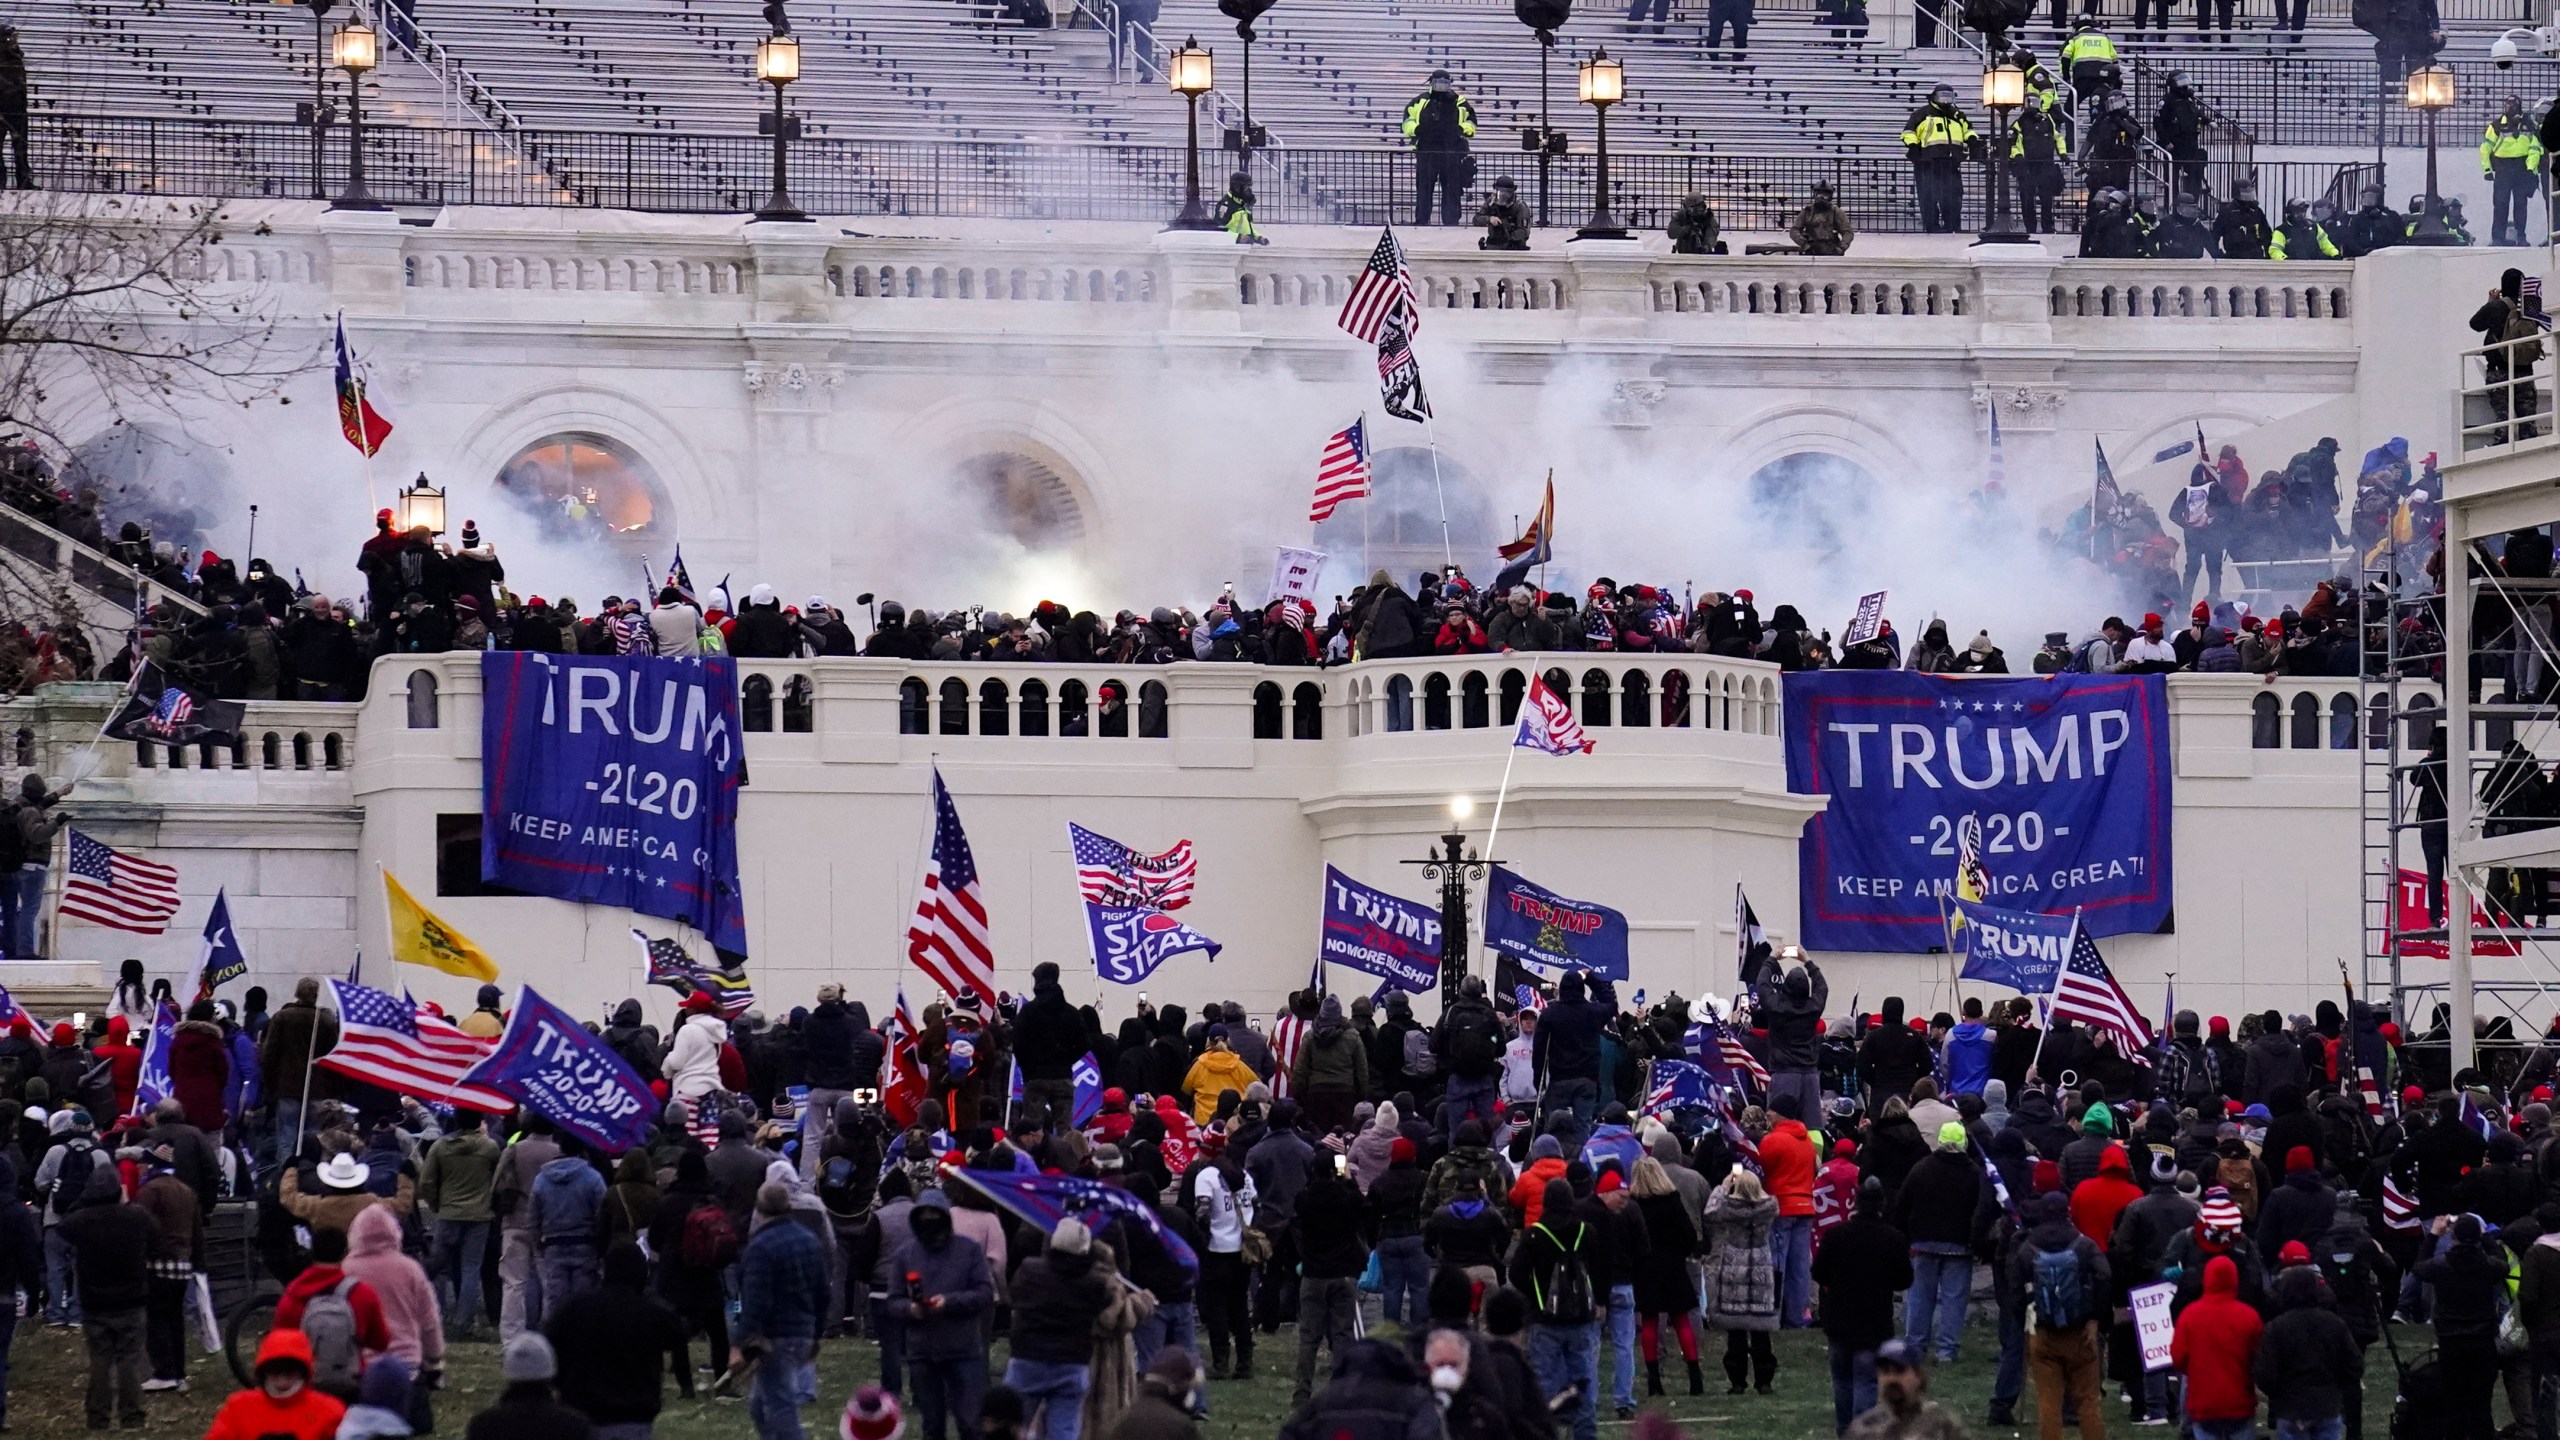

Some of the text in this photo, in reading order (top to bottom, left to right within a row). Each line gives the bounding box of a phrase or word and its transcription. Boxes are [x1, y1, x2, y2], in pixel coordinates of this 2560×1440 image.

[2083, 39, 2102, 47] POLICE
[1863, 594, 1882, 637] TRUMP
[1828, 709, 2130, 790] TRUMP
[509, 812, 572, 842] KEEP
[1130, 851, 1180, 873] GUNS
[1838, 875, 1904, 897] KEEP
[1914, 874, 2040, 897] AMICA
[1332, 879, 1442, 945] TRUMP
[1508, 891, 1602, 935] TRUMP
[1500, 938, 1527, 951] KEEP
[1528, 947, 1573, 965] AMERICA
[2023, 964, 2053, 975] GREAT
[531, 1020, 641, 1120] TRUMP
[1652, 1096, 1685, 1114] KEEP
[2134, 1292, 2164, 1310] KEEP
[2141, 1322, 2157, 1335] TO
